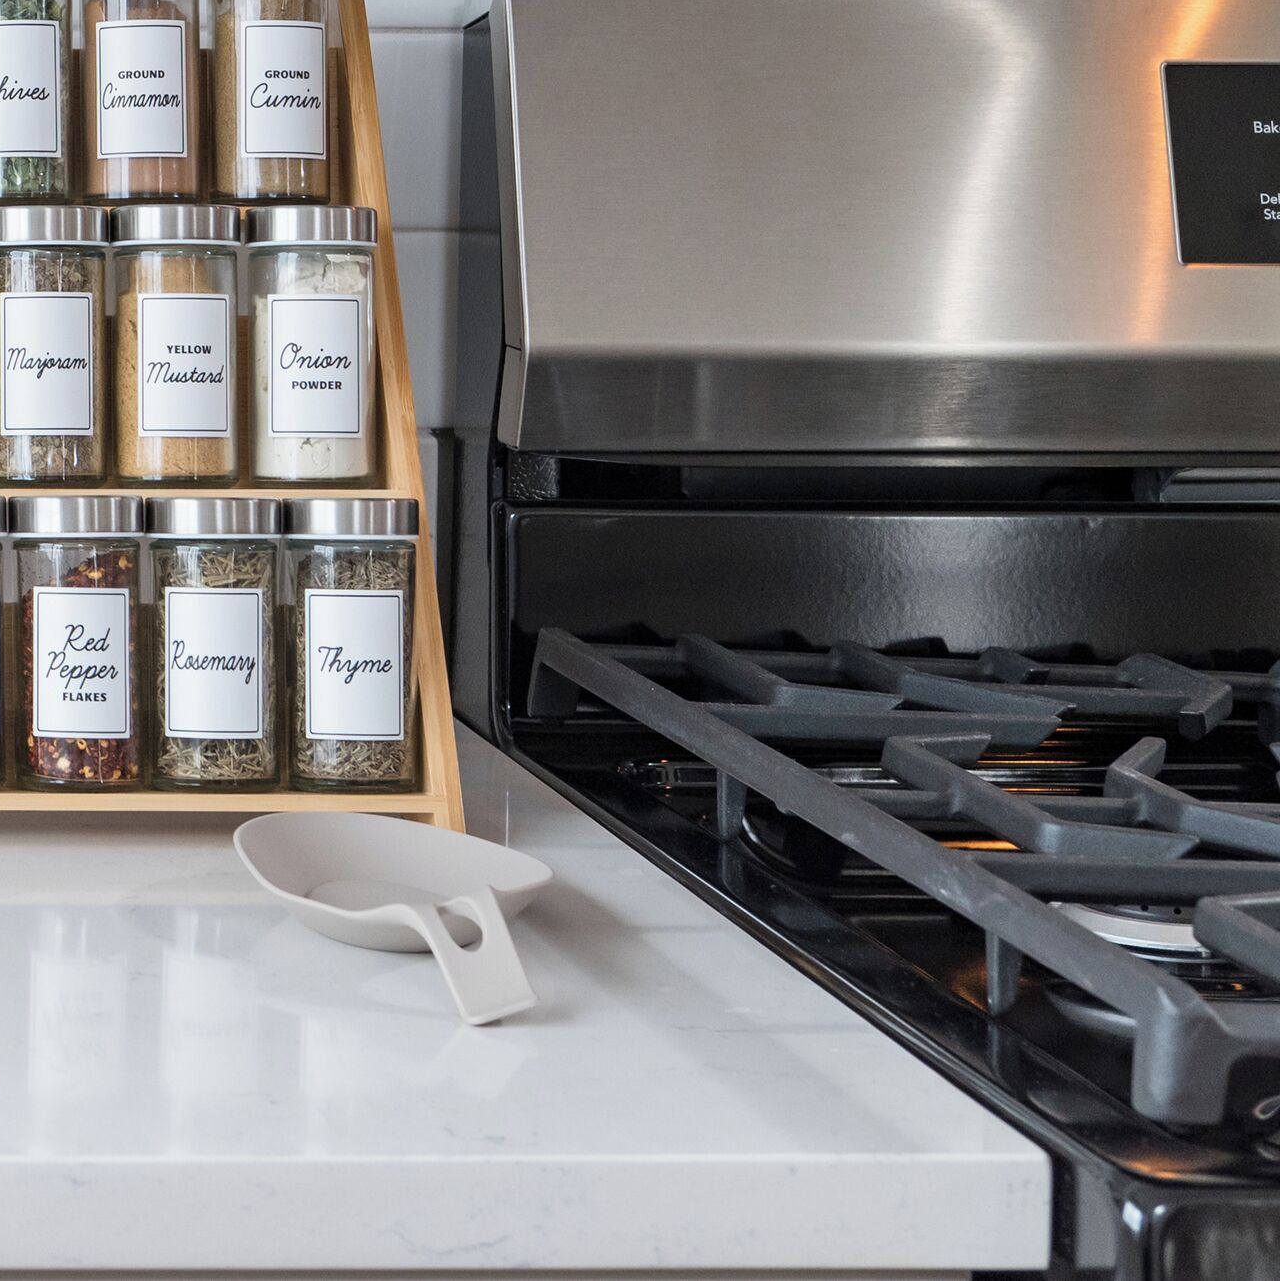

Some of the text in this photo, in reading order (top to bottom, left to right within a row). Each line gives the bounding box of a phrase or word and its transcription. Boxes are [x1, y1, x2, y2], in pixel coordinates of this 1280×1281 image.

[117, 69, 166, 80] GROUND
[264, 69, 311, 80] GROUND
[102, 82, 181, 111] Cinnamon
[251, 82, 322, 110] Cumin
[1253, 120, 1280, 134] Bak
[7, 347, 88, 380] Marjoram
[166, 344, 212, 355] YELLOW
[280, 342, 352, 370] Onion
[146, 361, 225, 385] Mustard
[291, 380, 343, 391] POWDER
[63, 624, 111, 652] Red
[46, 649, 119, 690] Pepper
[172, 639, 257, 685] Rosemary
[318, 646, 393, 685] Thyme
[62, 692, 107, 703] FLAKES
